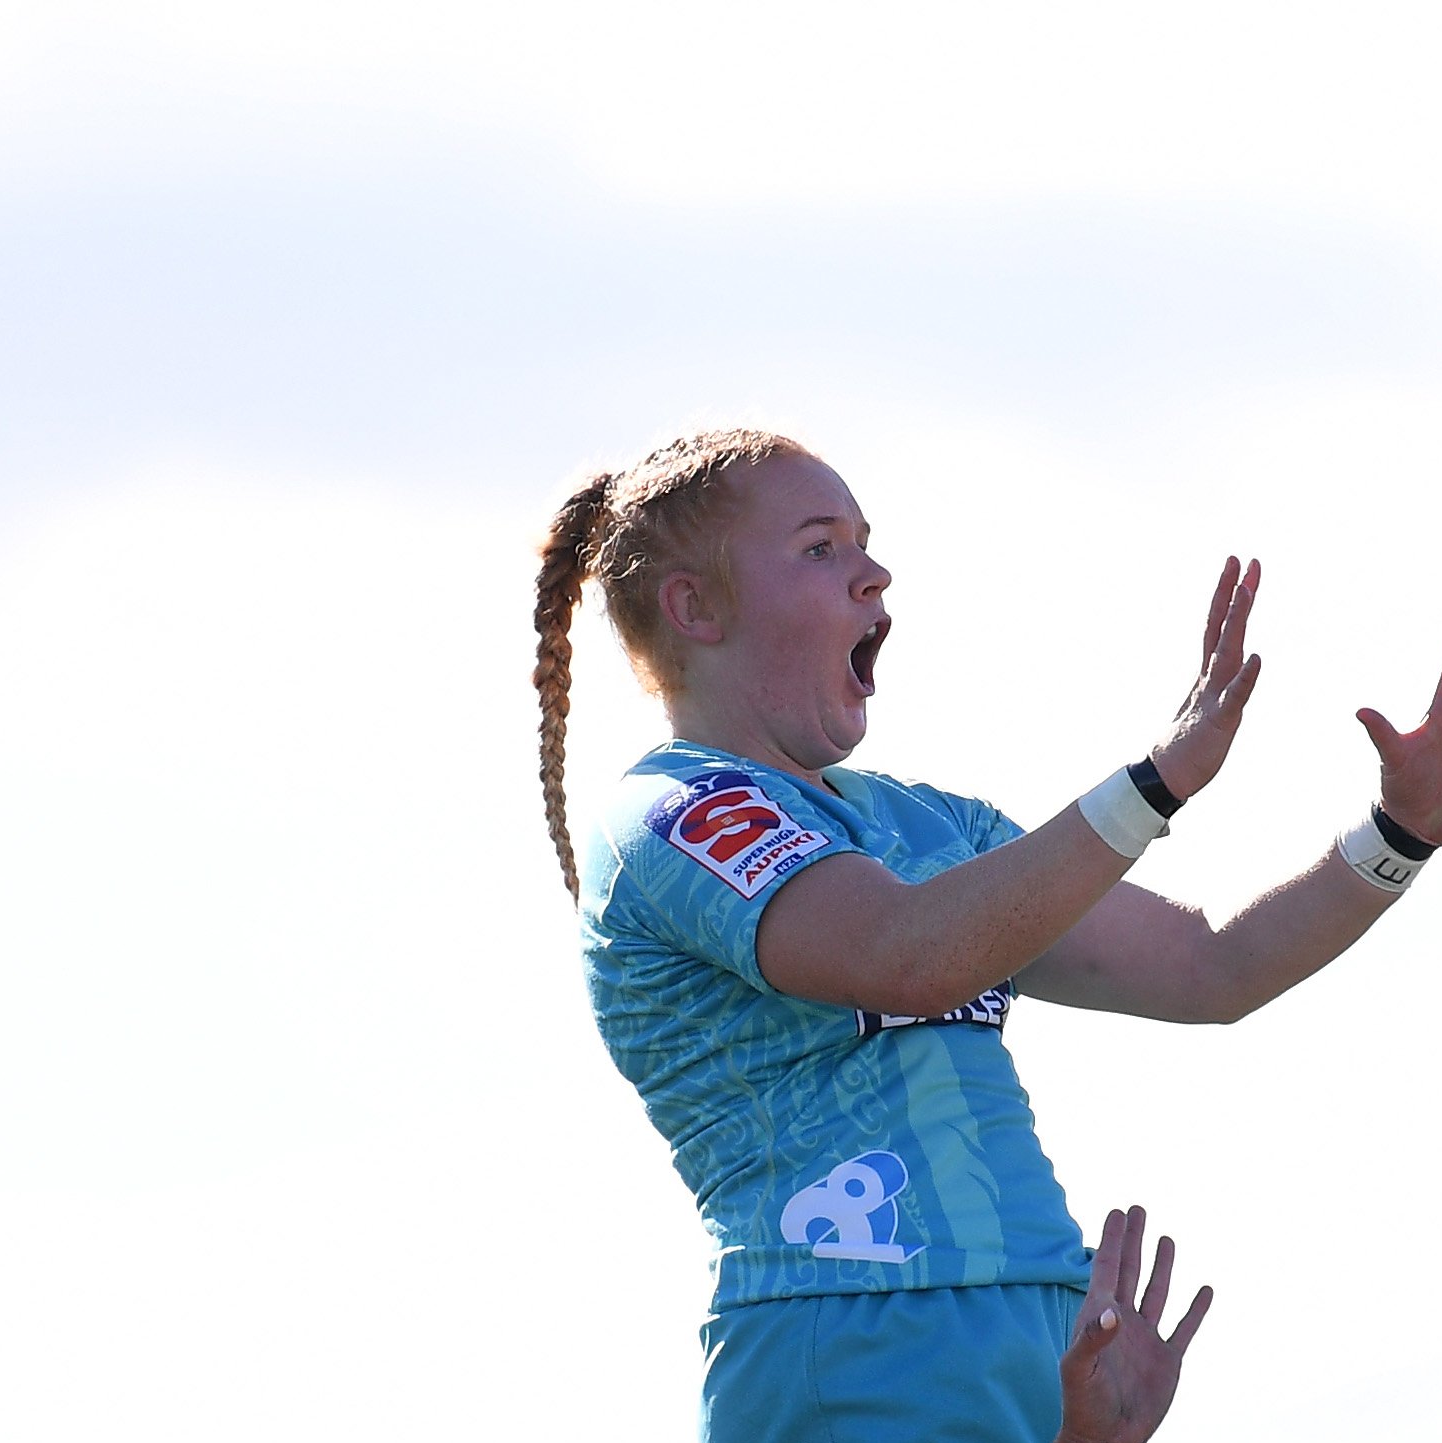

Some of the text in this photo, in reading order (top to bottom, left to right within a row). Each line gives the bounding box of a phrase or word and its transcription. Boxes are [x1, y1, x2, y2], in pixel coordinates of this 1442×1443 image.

[663, 774, 721, 814] sky
[732, 845, 767, 877] SUPER
[744, 831, 816, 888] AUPIKI
[776, 854, 803, 876] NZL
